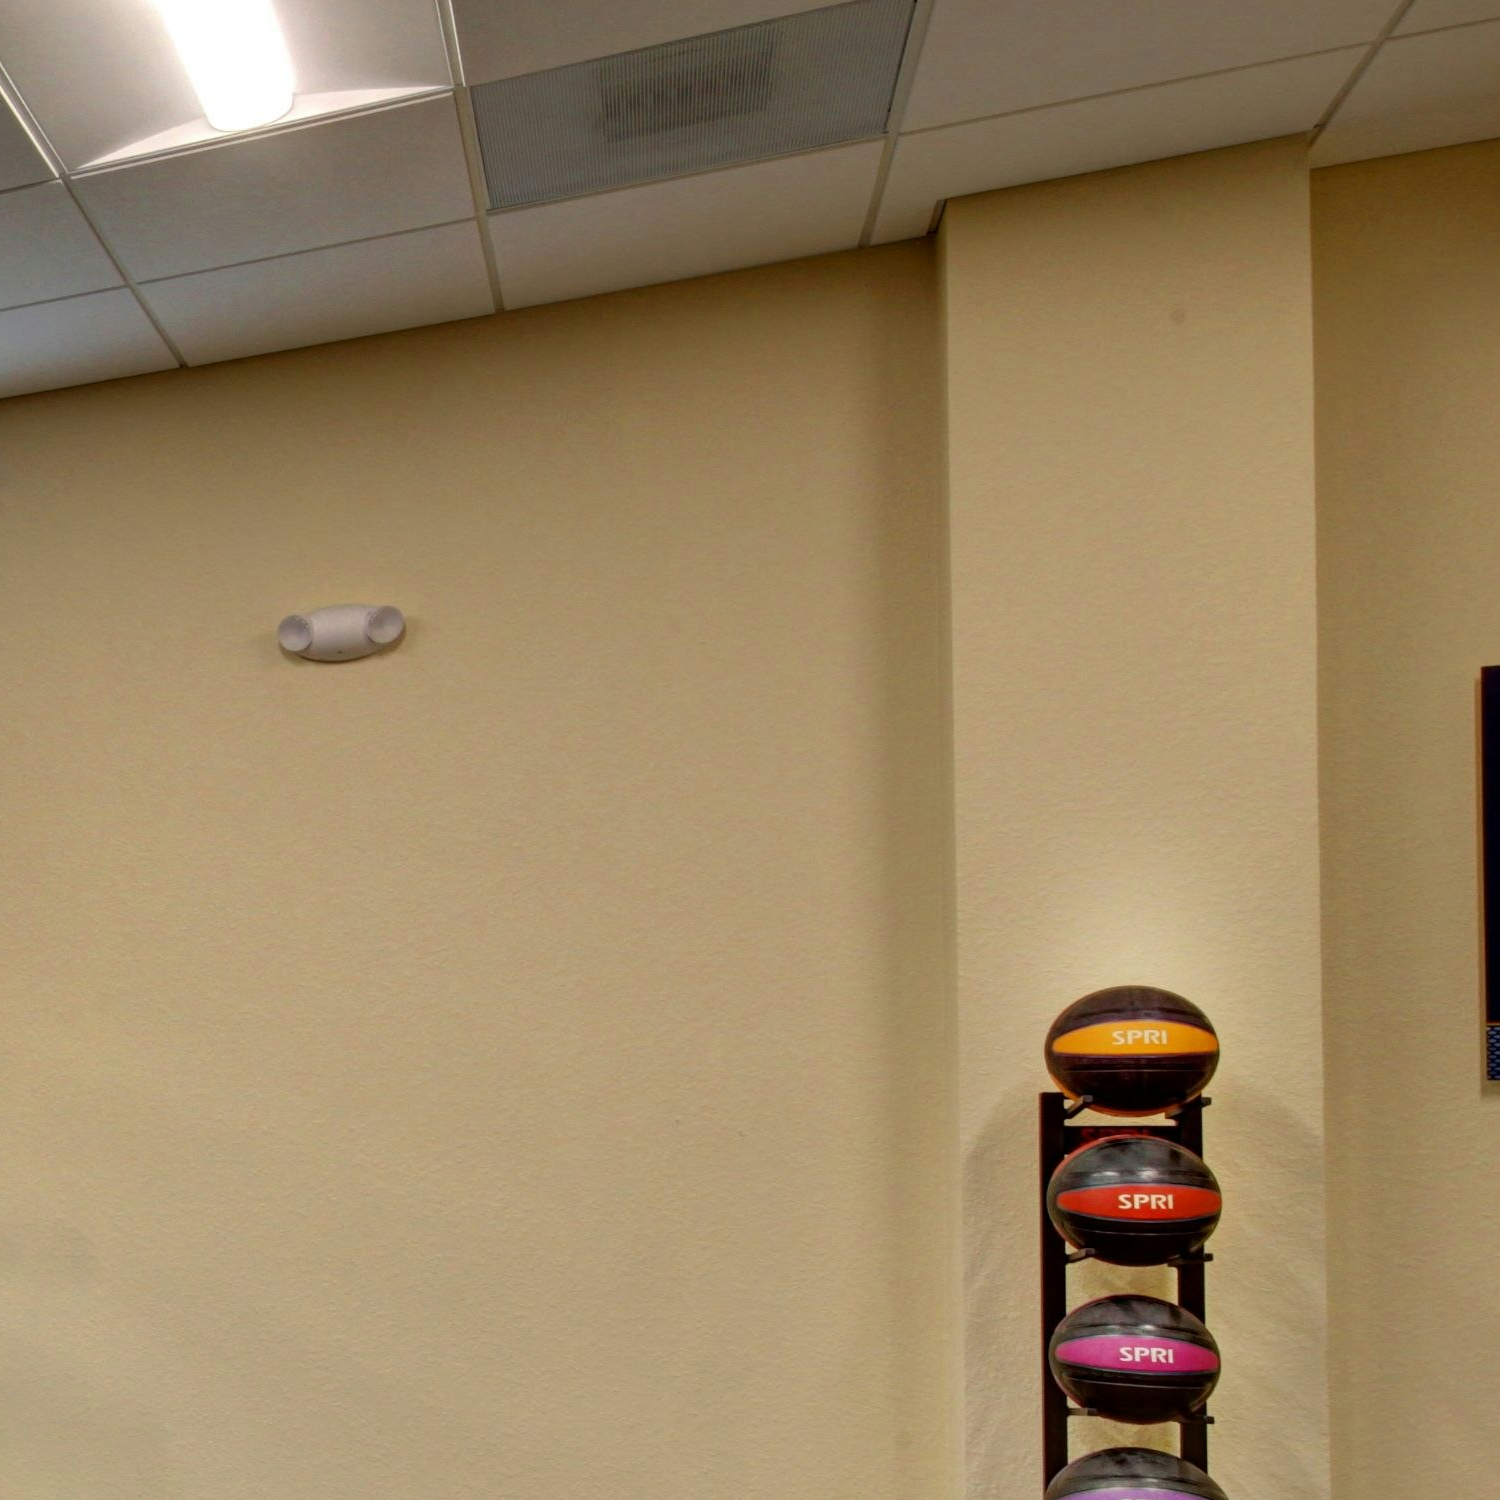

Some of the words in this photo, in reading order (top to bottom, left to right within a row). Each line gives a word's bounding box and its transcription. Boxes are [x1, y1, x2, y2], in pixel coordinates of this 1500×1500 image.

[1111, 1029, 1168, 1046] SPRI
[1118, 1193, 1175, 1210] SPRI
[1119, 1346, 1175, 1364] SPRI
